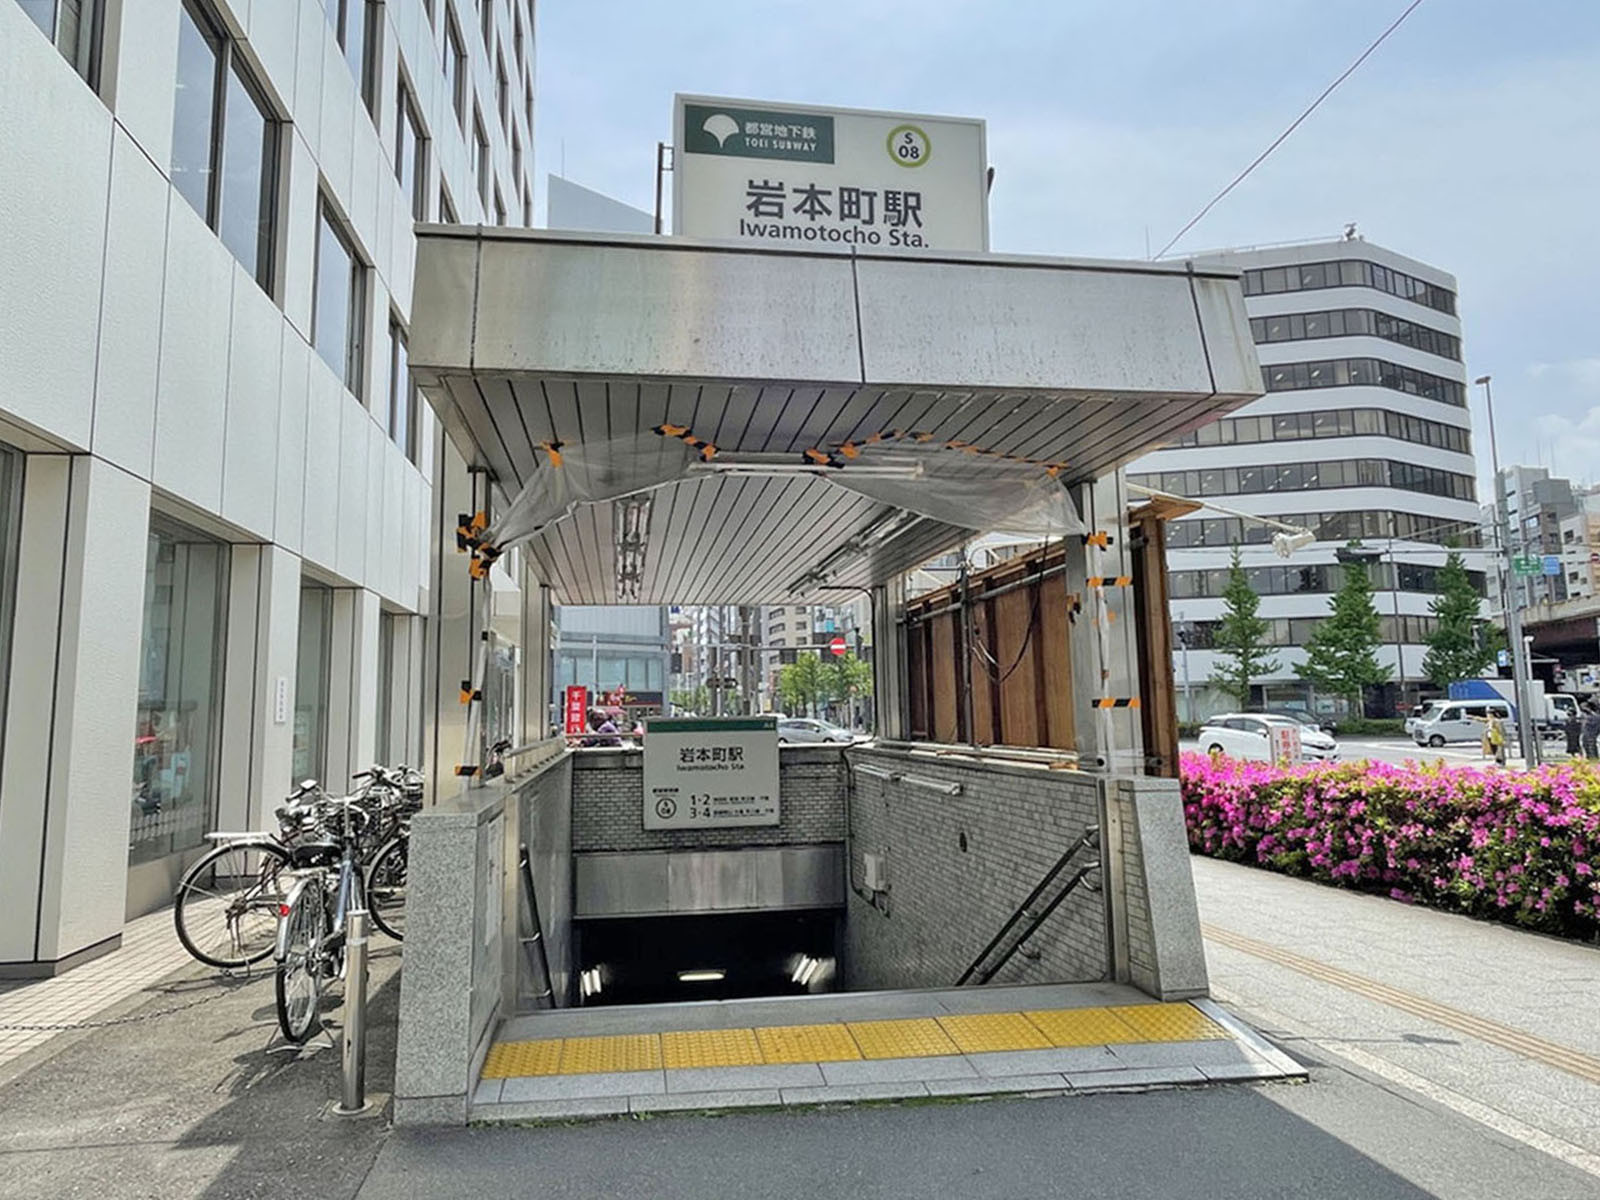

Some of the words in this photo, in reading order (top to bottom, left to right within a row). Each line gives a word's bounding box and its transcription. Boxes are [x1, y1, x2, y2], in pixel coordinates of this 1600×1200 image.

[745, 122, 816, 139] 都営地下鉄
[745, 137, 769, 148] TOEI
[773, 140, 817, 151] SUBWAY
[904, 132, 913, 145] S
[898, 145, 920, 159] 08
[746, 180, 923, 228] 岩本町駅
[740, 219, 881, 245] Iwamotocho
[889, 228, 930, 248] Sta.
[680, 747, 743, 762] 岩本町駅
